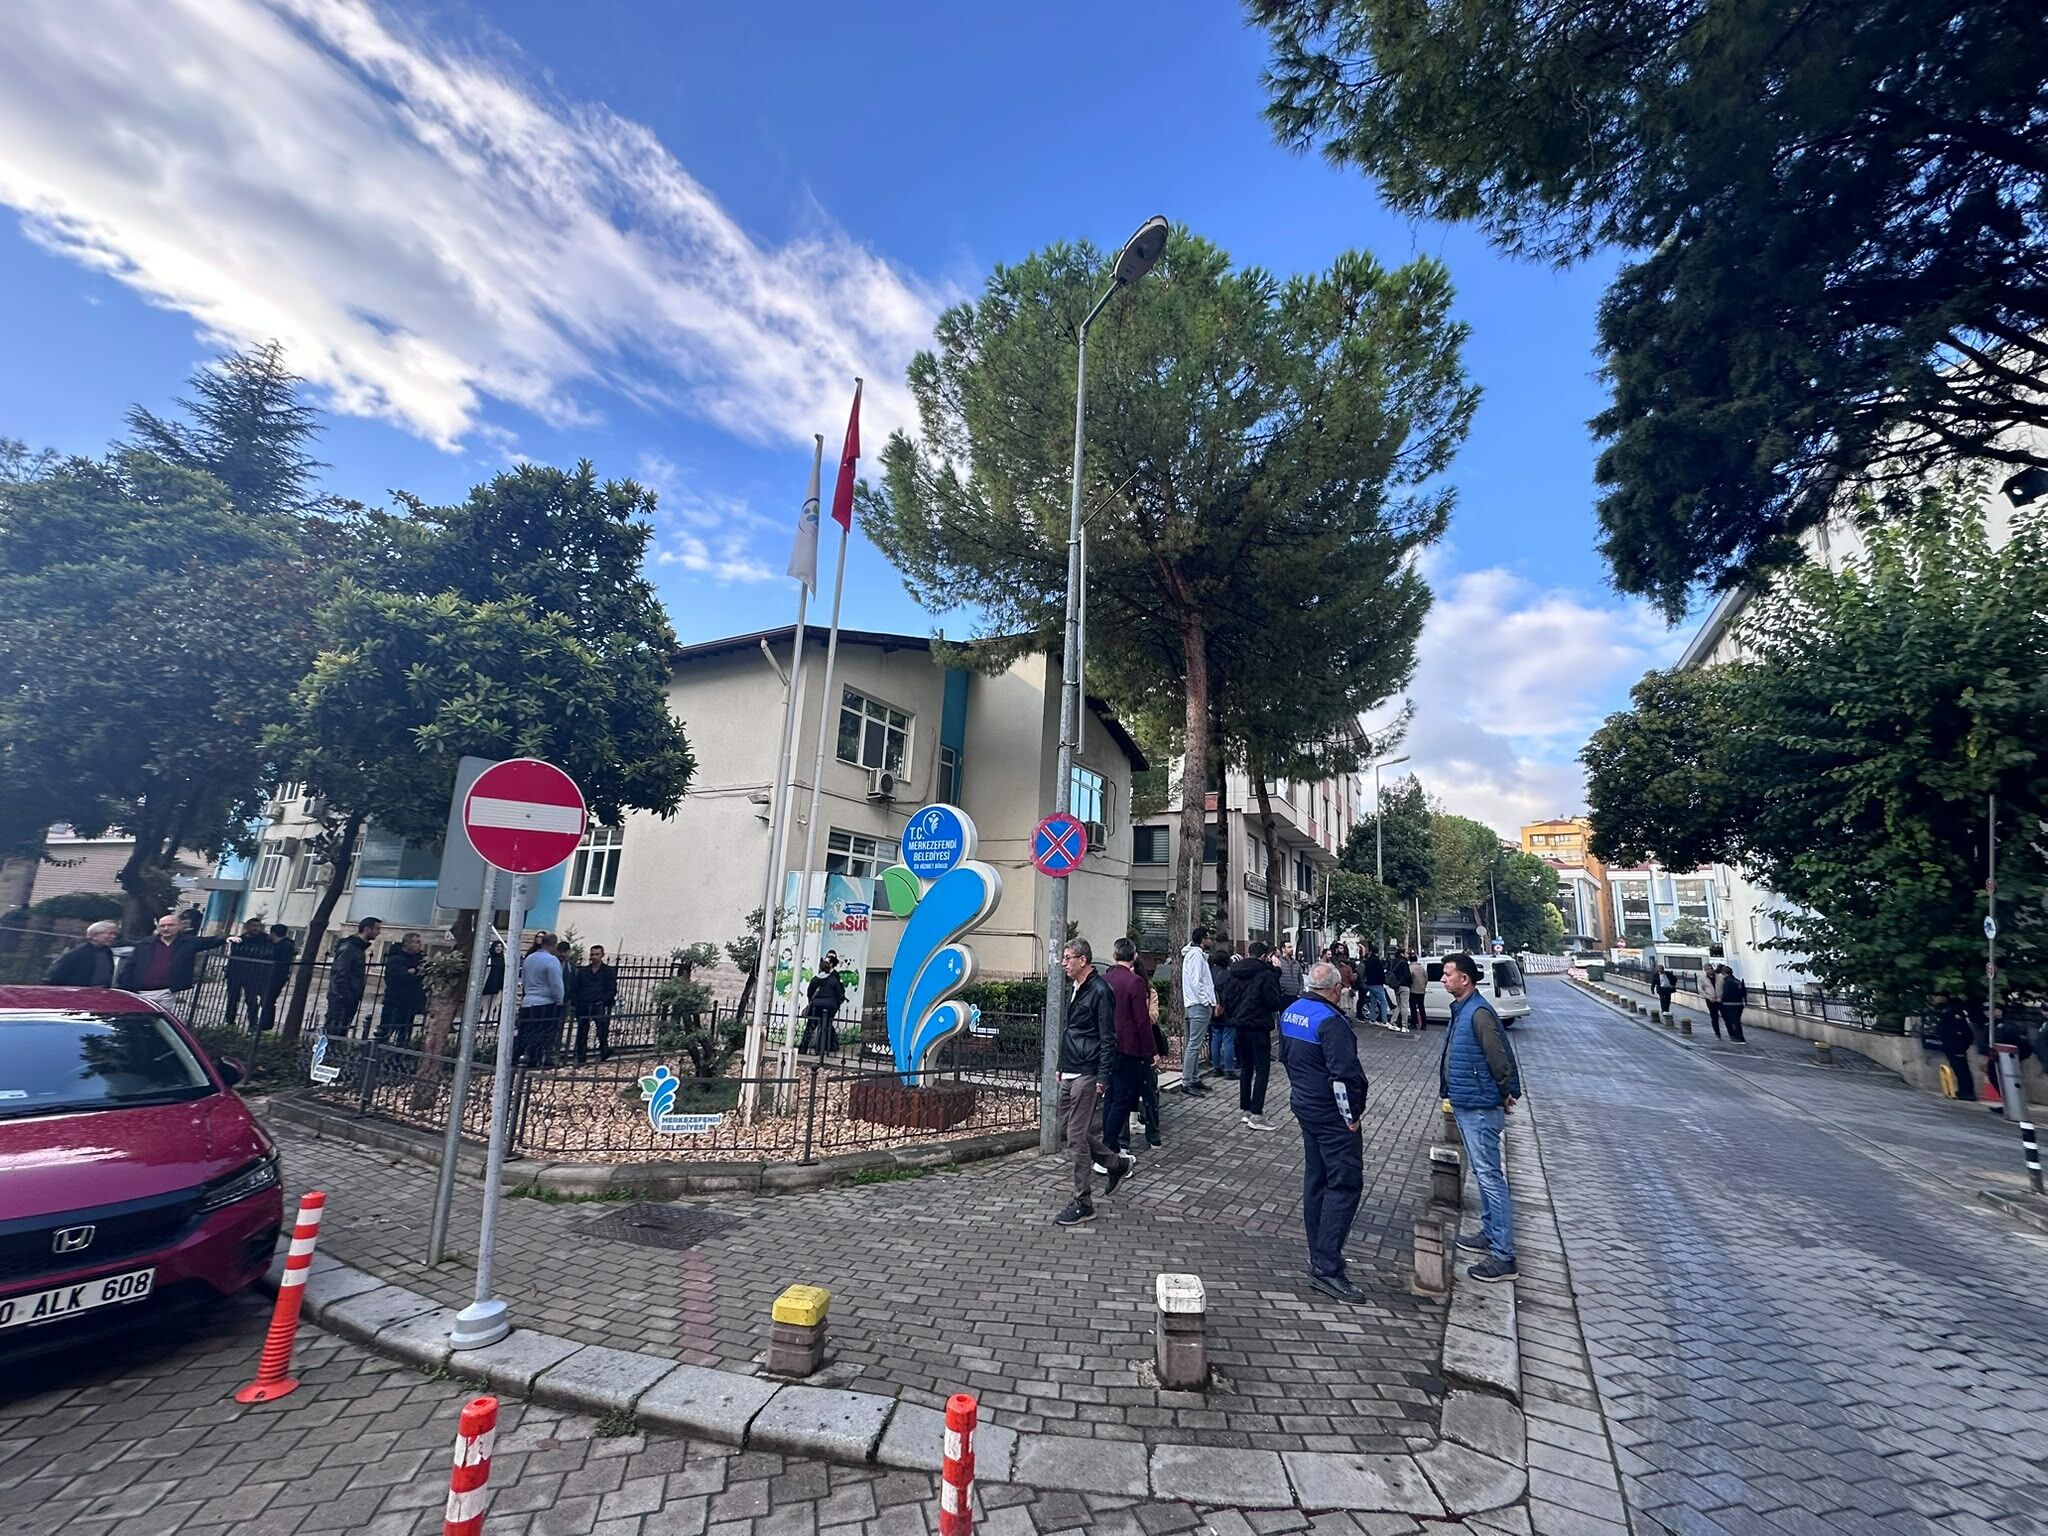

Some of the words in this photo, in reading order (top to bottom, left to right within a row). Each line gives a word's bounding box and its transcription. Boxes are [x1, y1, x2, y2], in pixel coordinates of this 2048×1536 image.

[909, 826, 925, 841] T.C.
[908, 837, 957, 850] MERKEZEFENDİ
[913, 850, 951, 861] BELEDİYESİ
[661, 1115, 721, 1123] MERKEZEFENDİ
[661, 1123, 706, 1131] BELEDİYESİ
[32, 1285, 86, 1318] ALK
[101, 1272, 150, 1301] 608
